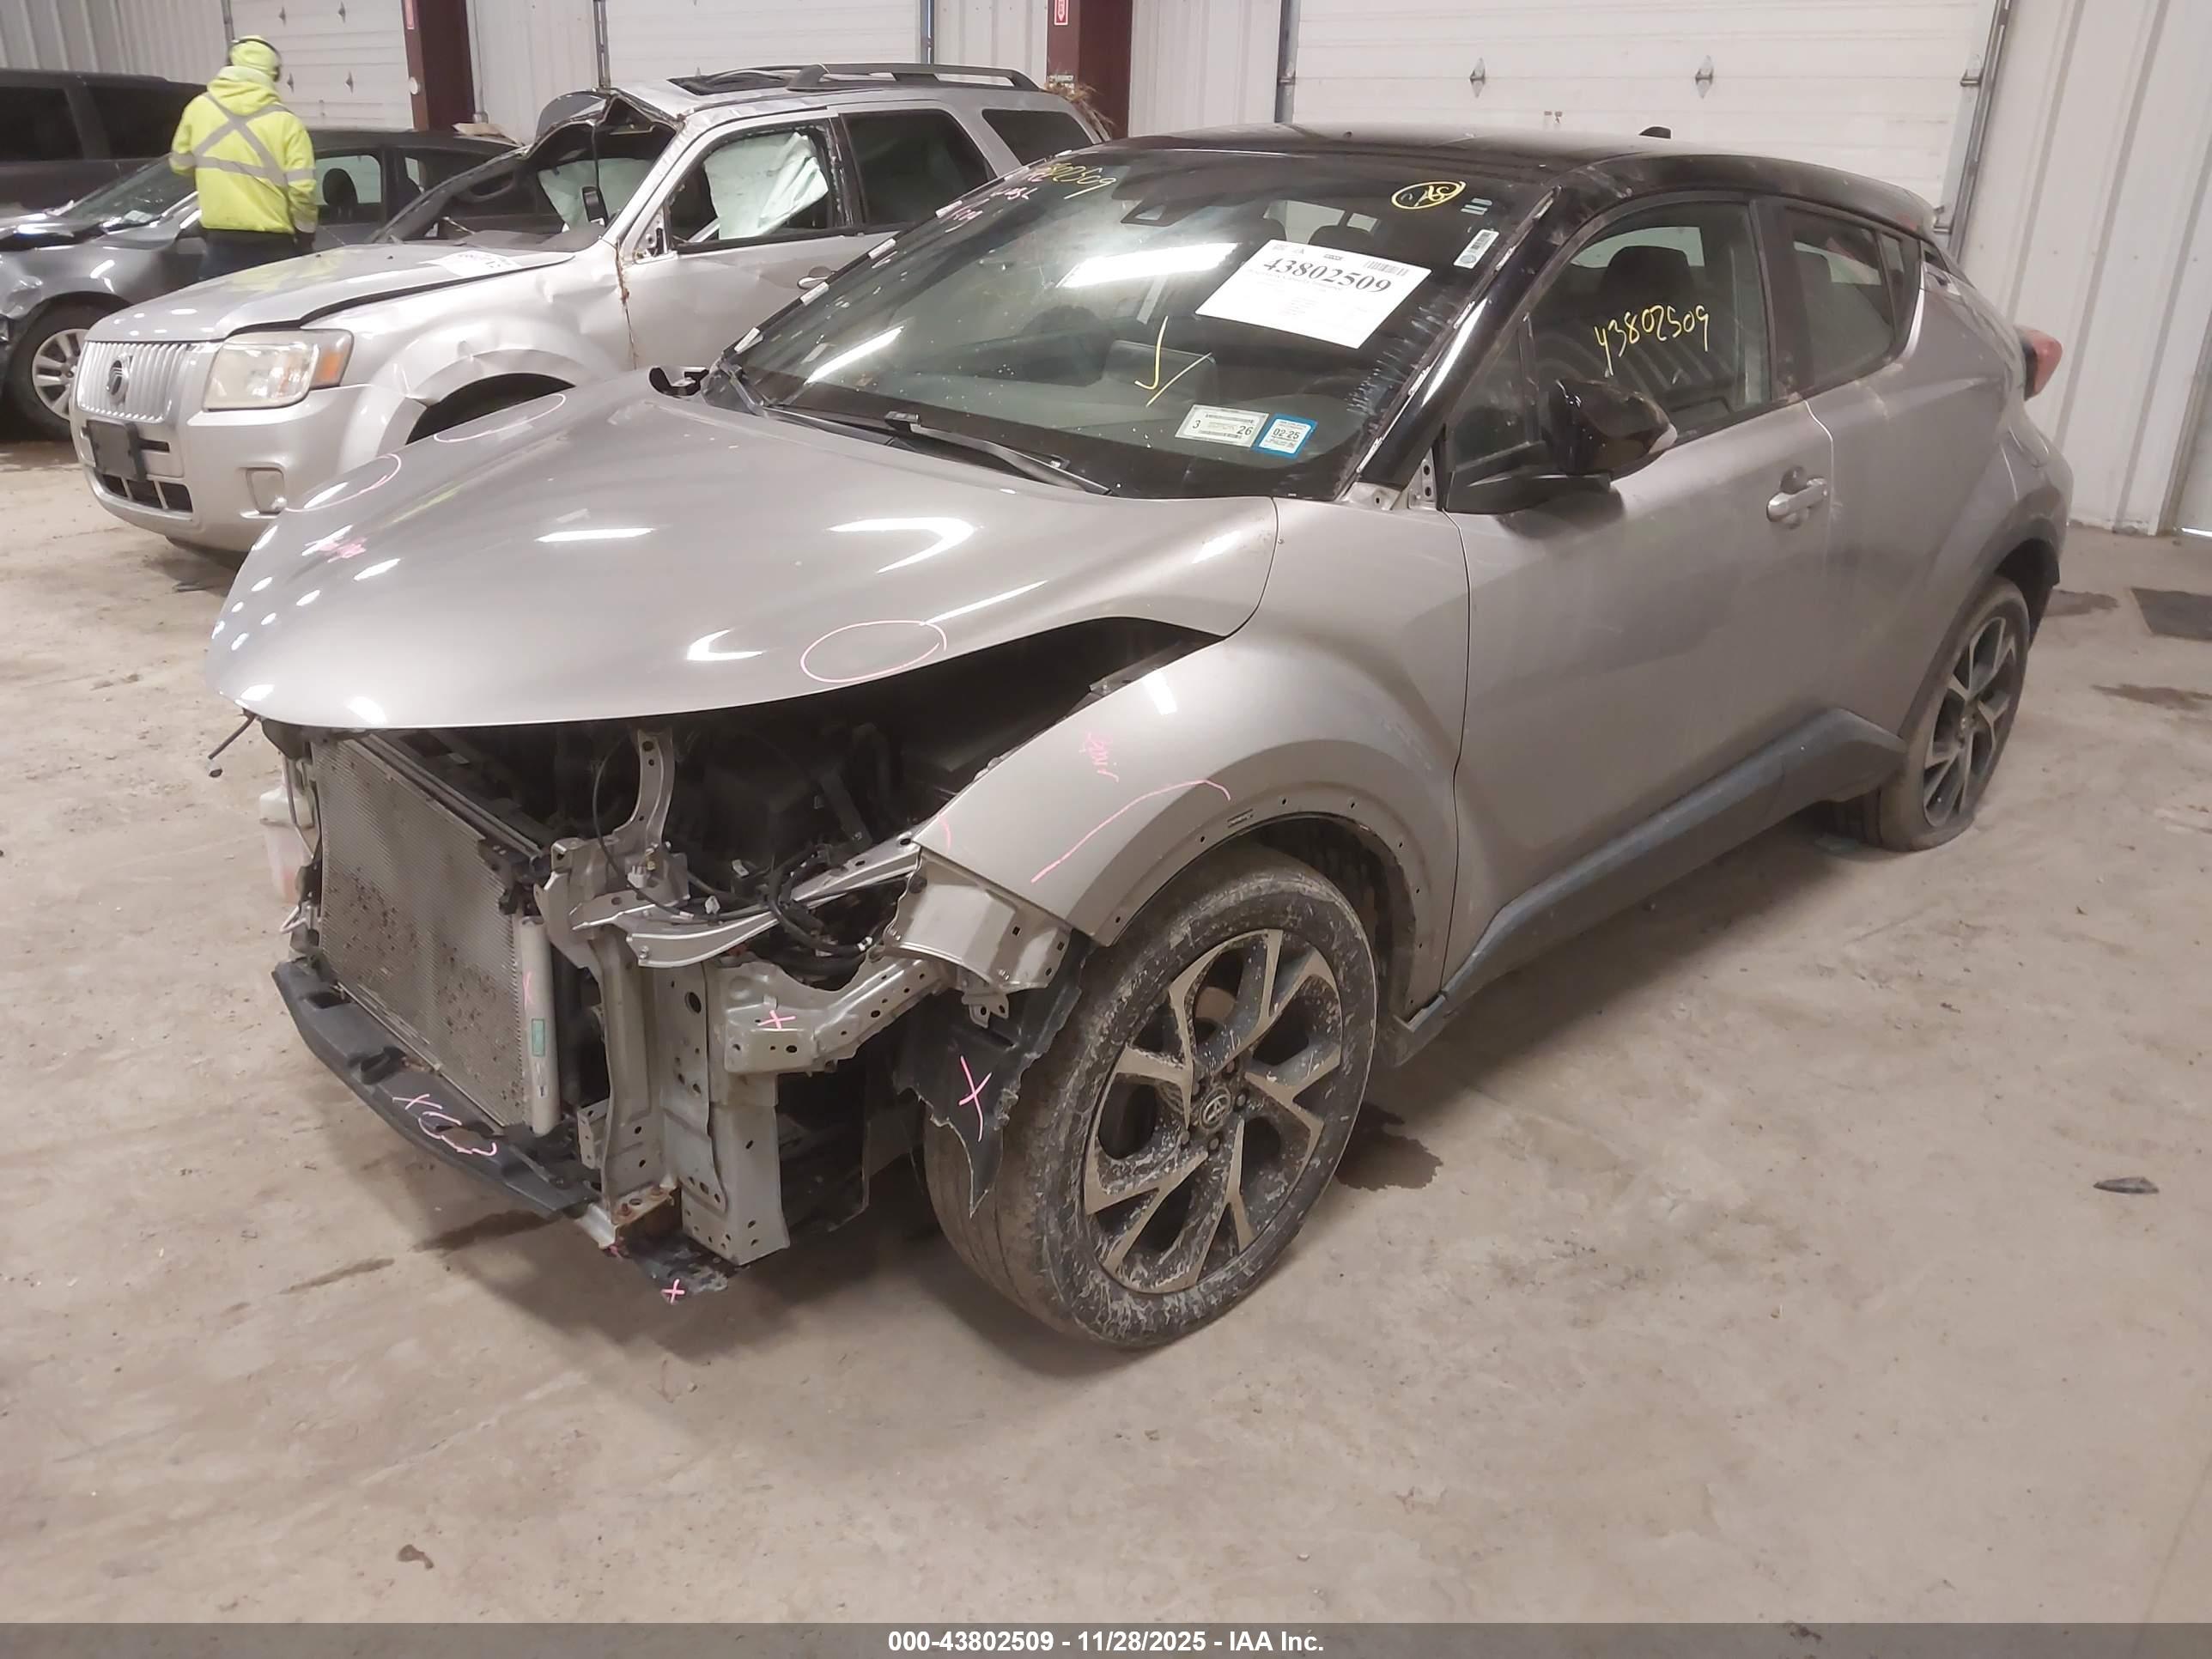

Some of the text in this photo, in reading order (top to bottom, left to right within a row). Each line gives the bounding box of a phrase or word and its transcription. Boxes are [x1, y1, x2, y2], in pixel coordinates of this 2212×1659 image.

[1263, 258, 1392, 293] 43802509
[1593, 304, 1710, 376] 43802509
[1192, 419, 1201, 429] 3
[1237, 425, 1254, 436] 26
